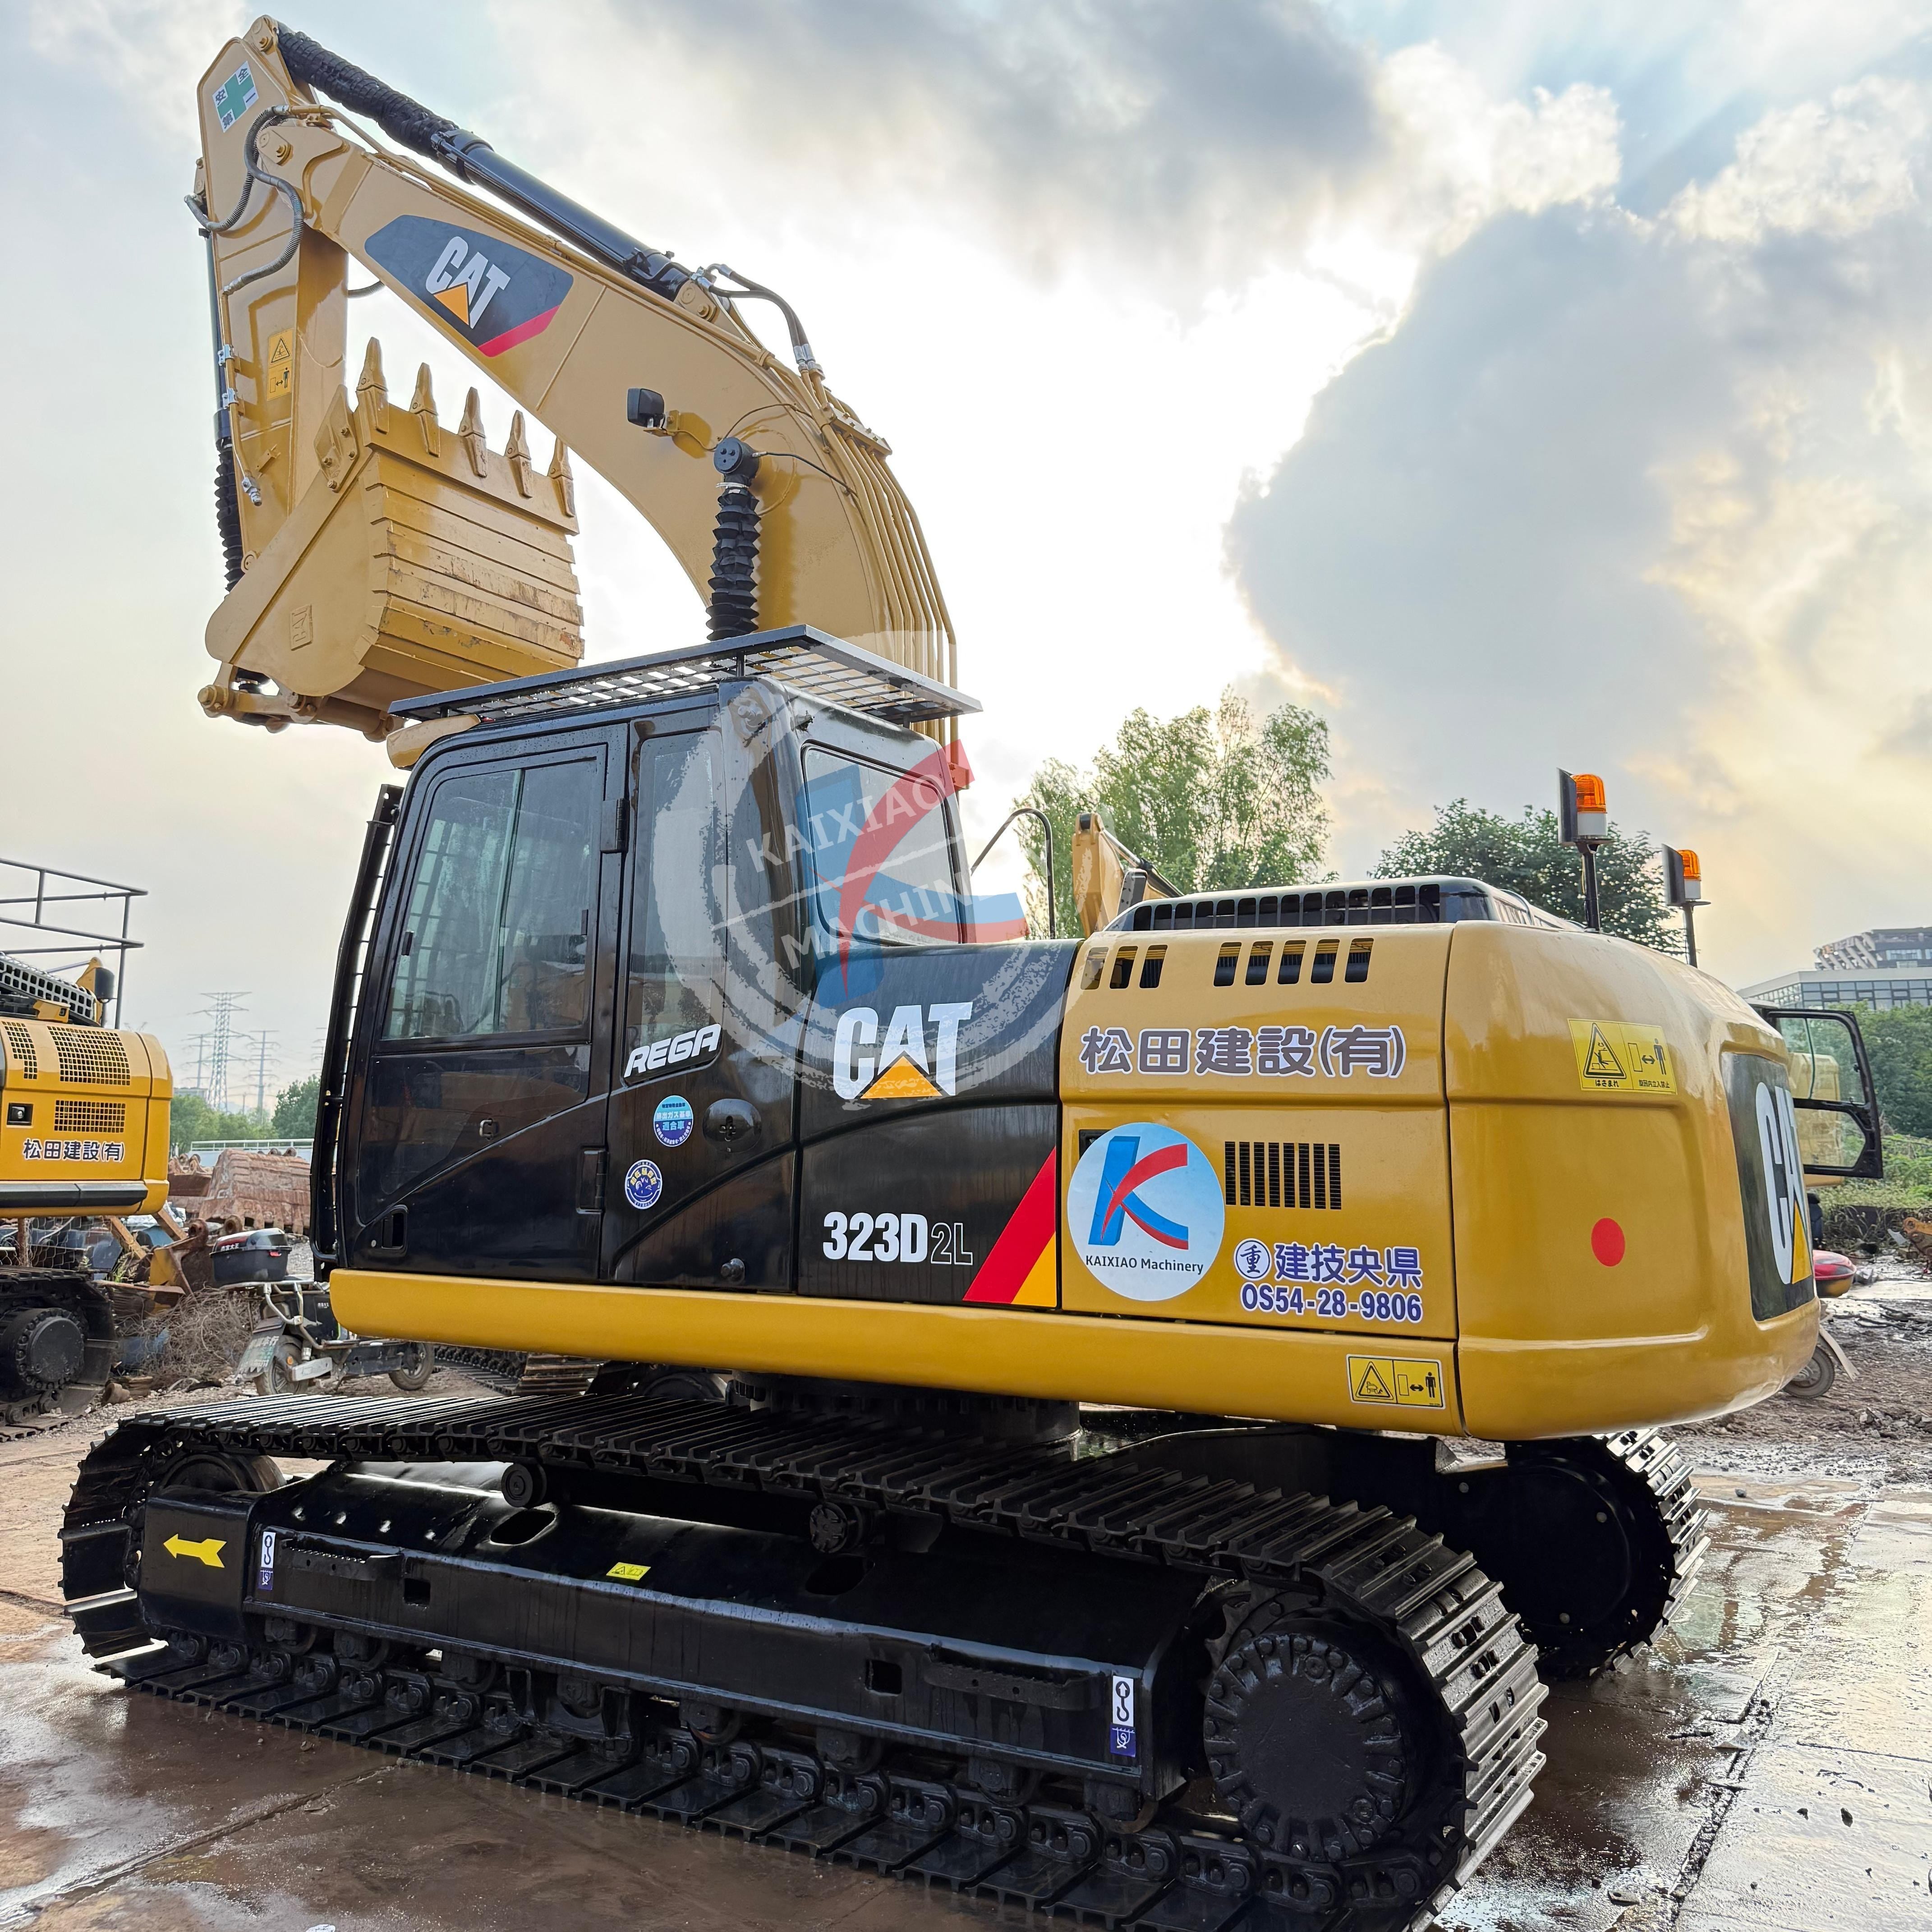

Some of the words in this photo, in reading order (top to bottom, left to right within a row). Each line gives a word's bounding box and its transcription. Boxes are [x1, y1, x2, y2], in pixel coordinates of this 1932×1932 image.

[426, 236, 511, 329] CAT
[624, 1023, 722, 1078] REGA
[833, 1002, 973, 1099] CAT
[1081, 1026, 1407, 1077] 松田建設(有)
[1595, 1079, 1619, 1088] はさまれ
[23, 1139, 124, 1162] 松田建設(有)
[1086, 1255, 1137, 1268] KAIXIAO
[1141, 1258, 1204, 1275] Machinery
[1274, 1243, 1421, 1288] 建技央県
